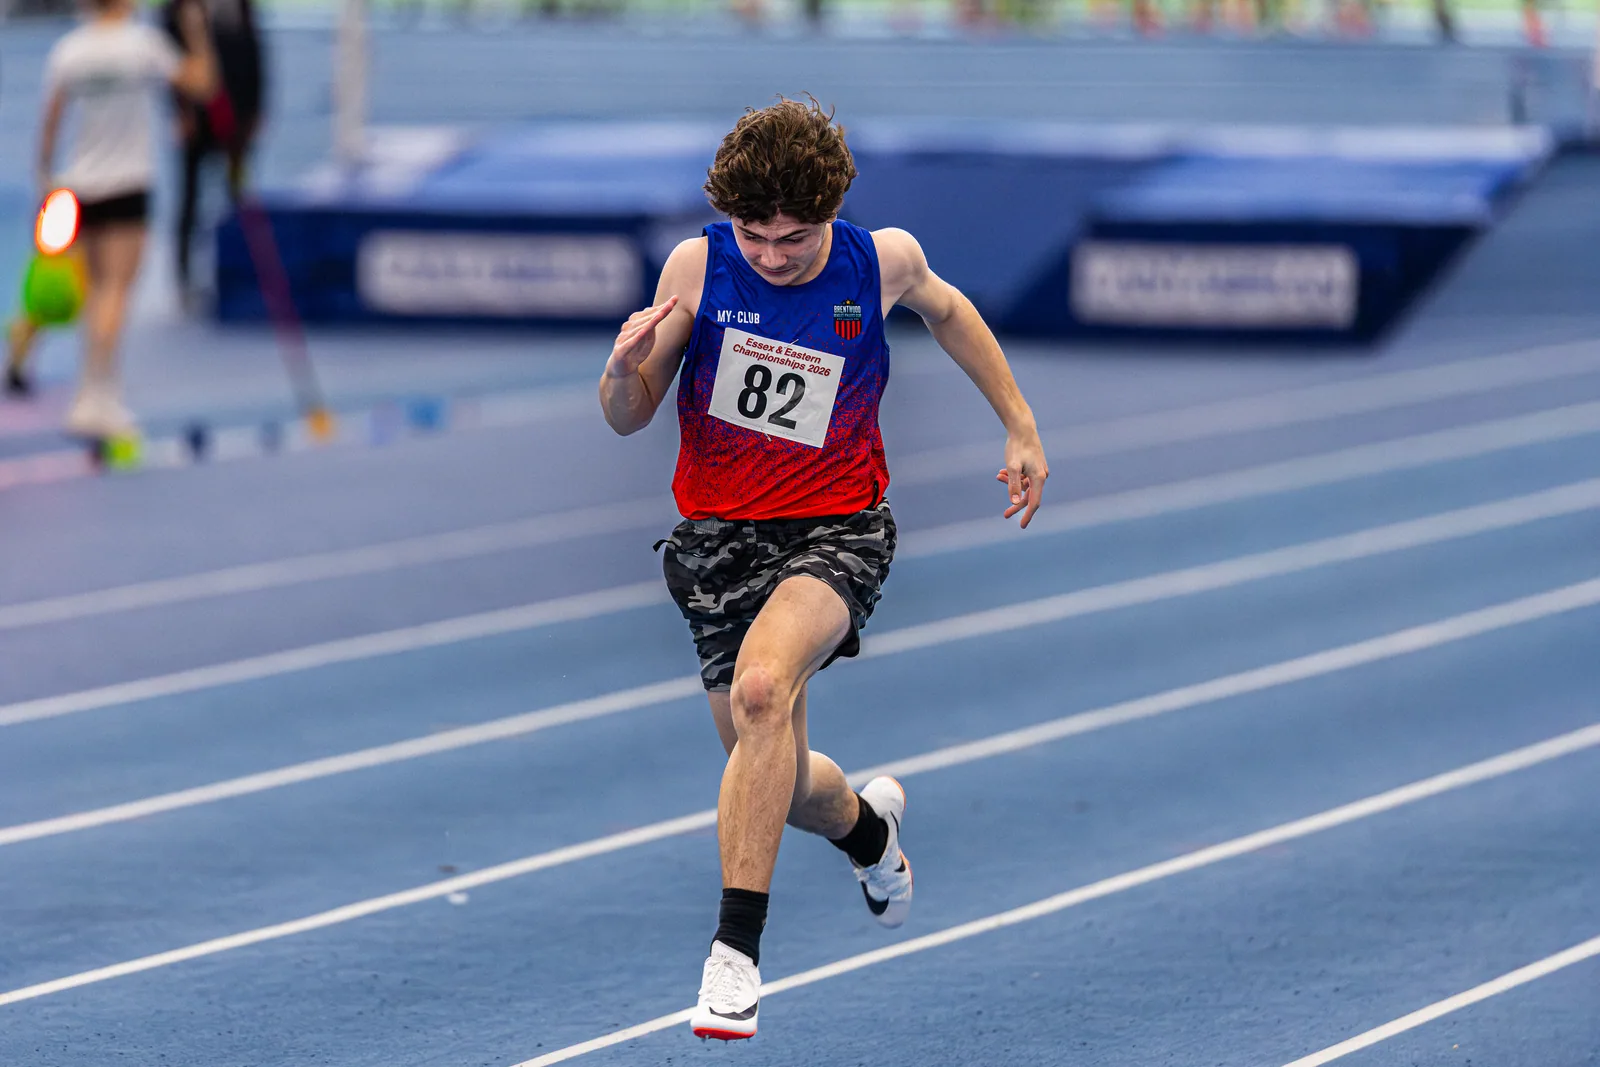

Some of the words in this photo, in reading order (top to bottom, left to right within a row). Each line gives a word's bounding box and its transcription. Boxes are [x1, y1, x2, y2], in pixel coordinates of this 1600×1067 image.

[732, 343, 806, 370] Championships
[807, 364, 832, 377] 2026
[745, 337, 775, 352] Essex
[775, 345, 783, 354] &
[784, 347, 821, 364] Eastern
[737, 364, 806, 430] 82
